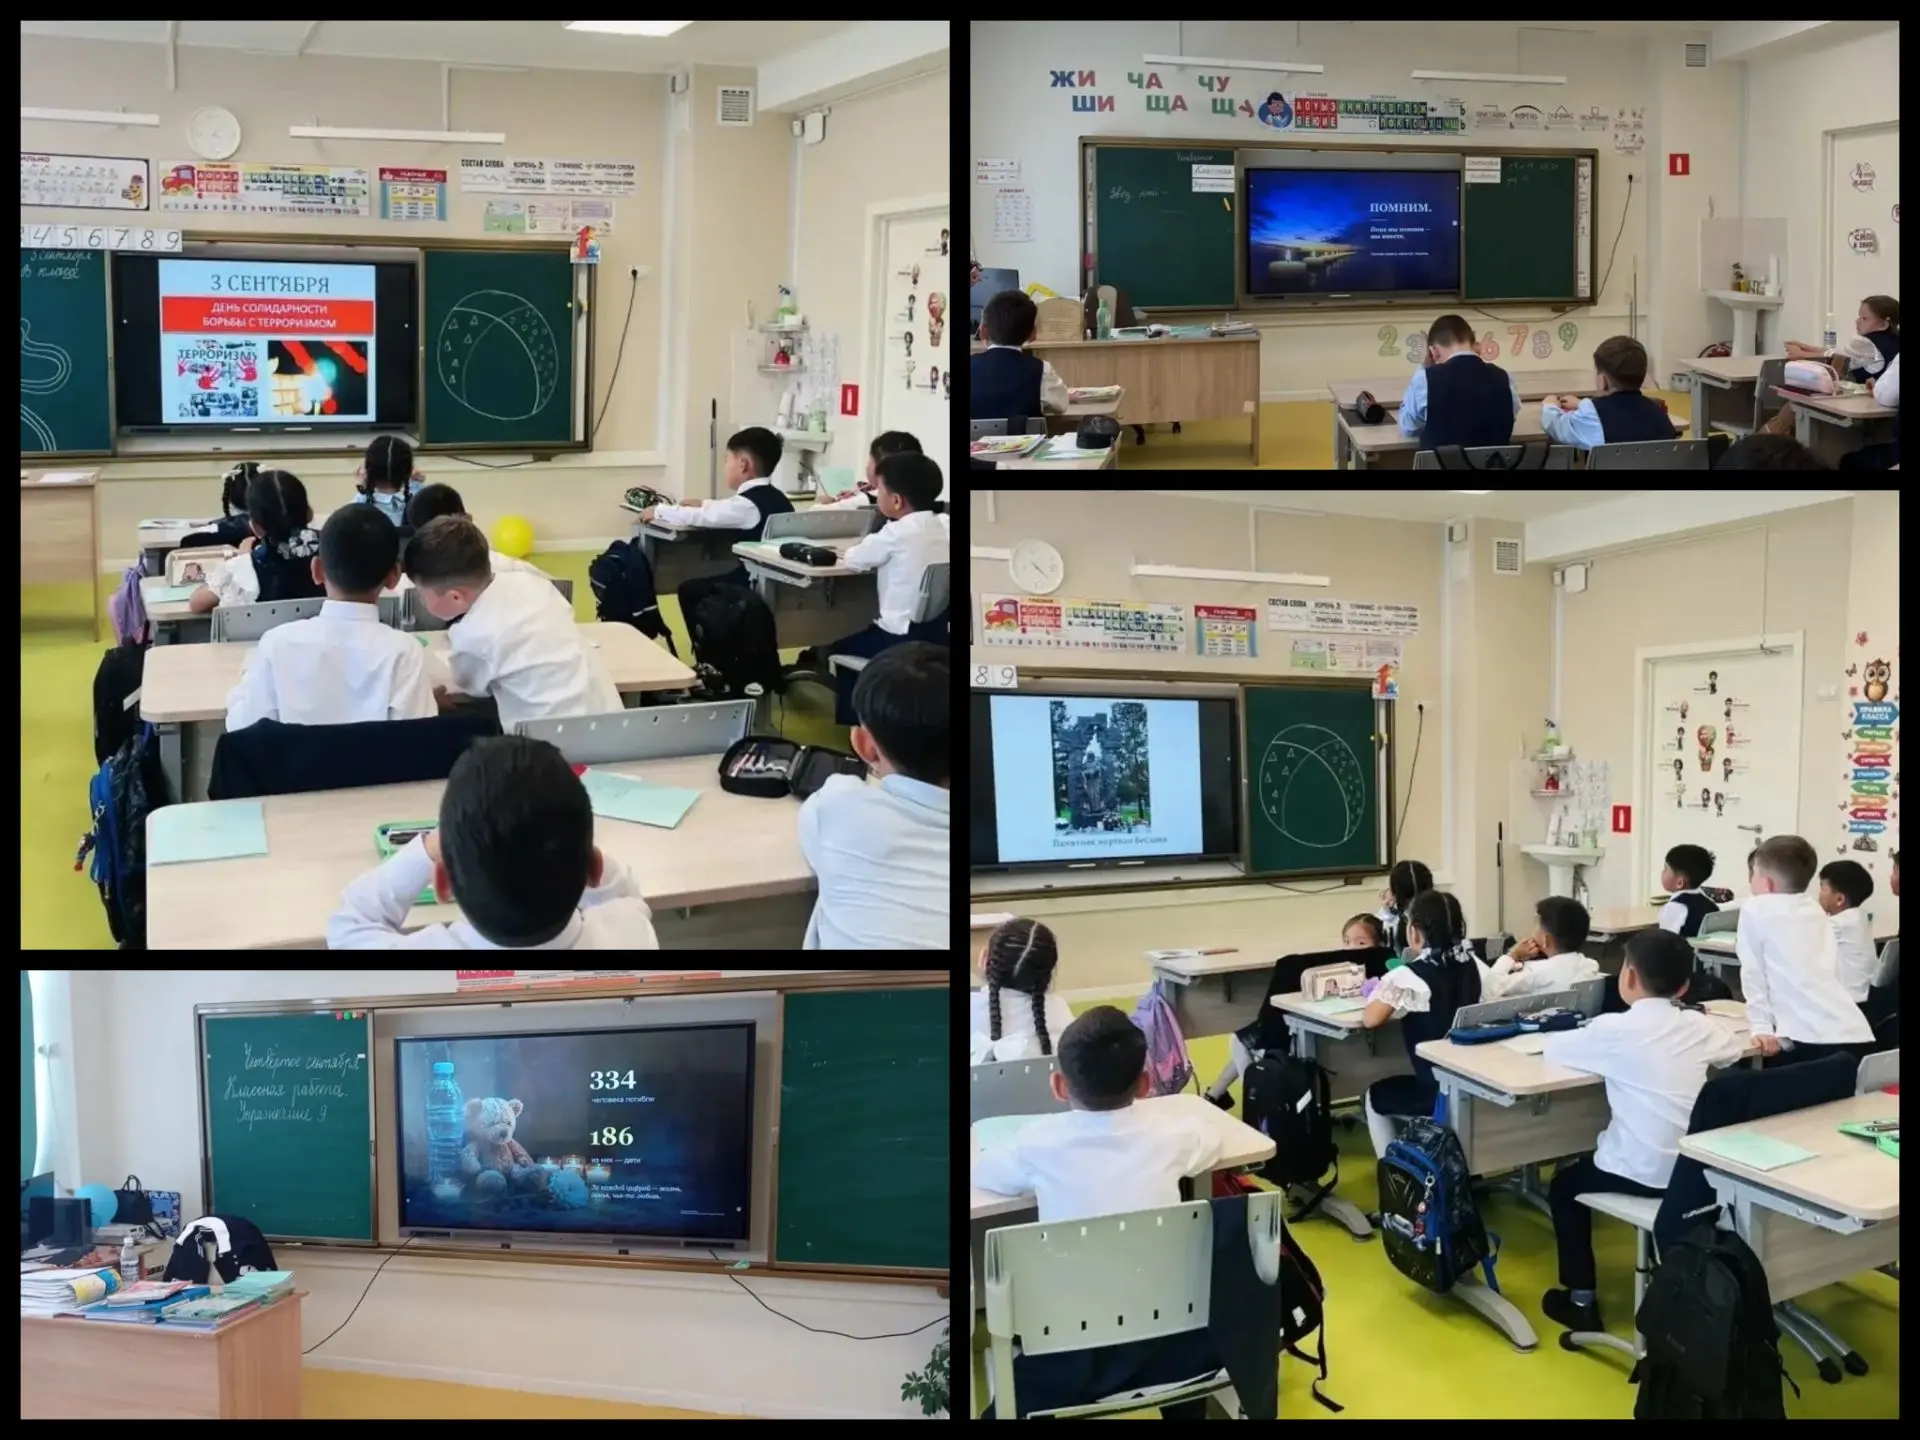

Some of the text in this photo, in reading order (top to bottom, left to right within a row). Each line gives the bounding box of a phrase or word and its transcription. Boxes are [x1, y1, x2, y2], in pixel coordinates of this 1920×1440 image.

[1050, 70, 1096, 87] ЖИ
[1127, 72, 1163, 89] ЧА
[1198, 75, 1231, 92] ЧУ
[1072, 95, 1115, 112] ШИ
[1146, 95, 1188, 114] ЩА
[1211, 98, 1254, 118] ЩУ
[1370, 203, 1432, 212] ПОМНИМ.
[33, 228, 180, 249] 4 5 6 7 8 9
[211, 274, 329, 293] 3 СЕНТЯБРЯ
[212, 303, 327, 313] ДЕНЬ СОЛИДАРНОСТИ
[203, 317, 336, 328] БОРЬБЫ С ТЕРРОРИЗМОМ
[1378, 325, 1400, 356] 2
[1481, 331, 1500, 361] 6
[1507, 325, 1529, 356] 7
[1532, 330, 1553, 359] 8
[1558, 322, 1578, 351] 9
[975, 666, 1014, 686] 8 9
[224, 1075, 286, 1100] Классная
[589, 1070, 637, 1090] 334
[317, 1105, 328, 1122] 9
[590, 1126, 634, 1146] 186
